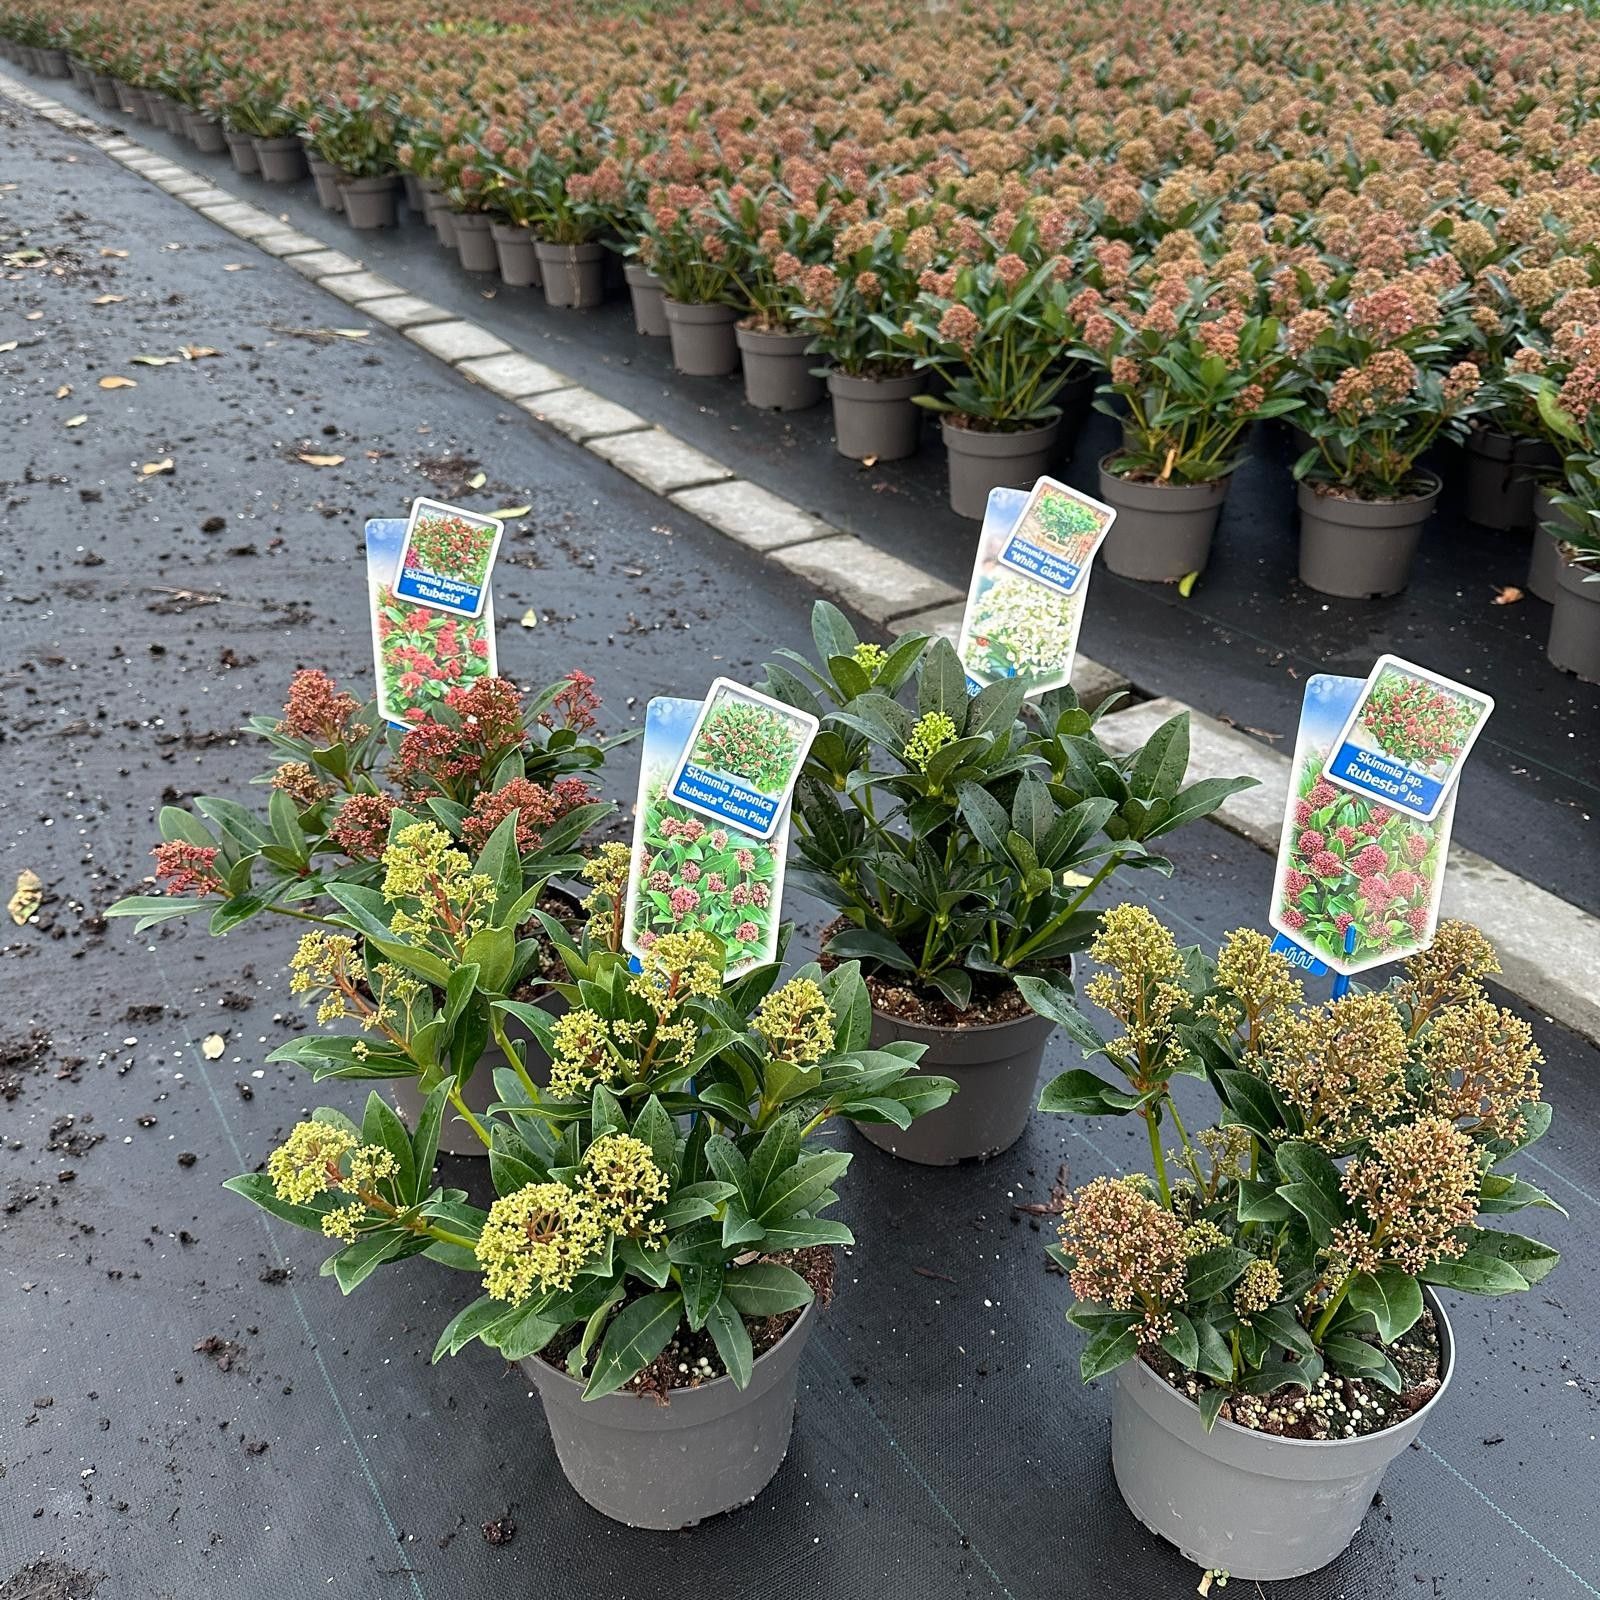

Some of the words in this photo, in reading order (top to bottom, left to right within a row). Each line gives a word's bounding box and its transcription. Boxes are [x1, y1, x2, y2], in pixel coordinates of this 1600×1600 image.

[1012, 540, 1045, 561] Skimmia
[1043, 555, 1077, 576] japonica
[404, 569, 442, 587] Skimmia
[442, 580, 478, 597] japonica
[1355, 751, 1403, 779] Skimmia
[1402, 771, 1424, 789] jap.
[685, 766, 730, 793] Skimmia
[729, 784, 773, 811] japonica
[722, 800, 749, 818] Giant
[748, 811, 770, 828] Pink
